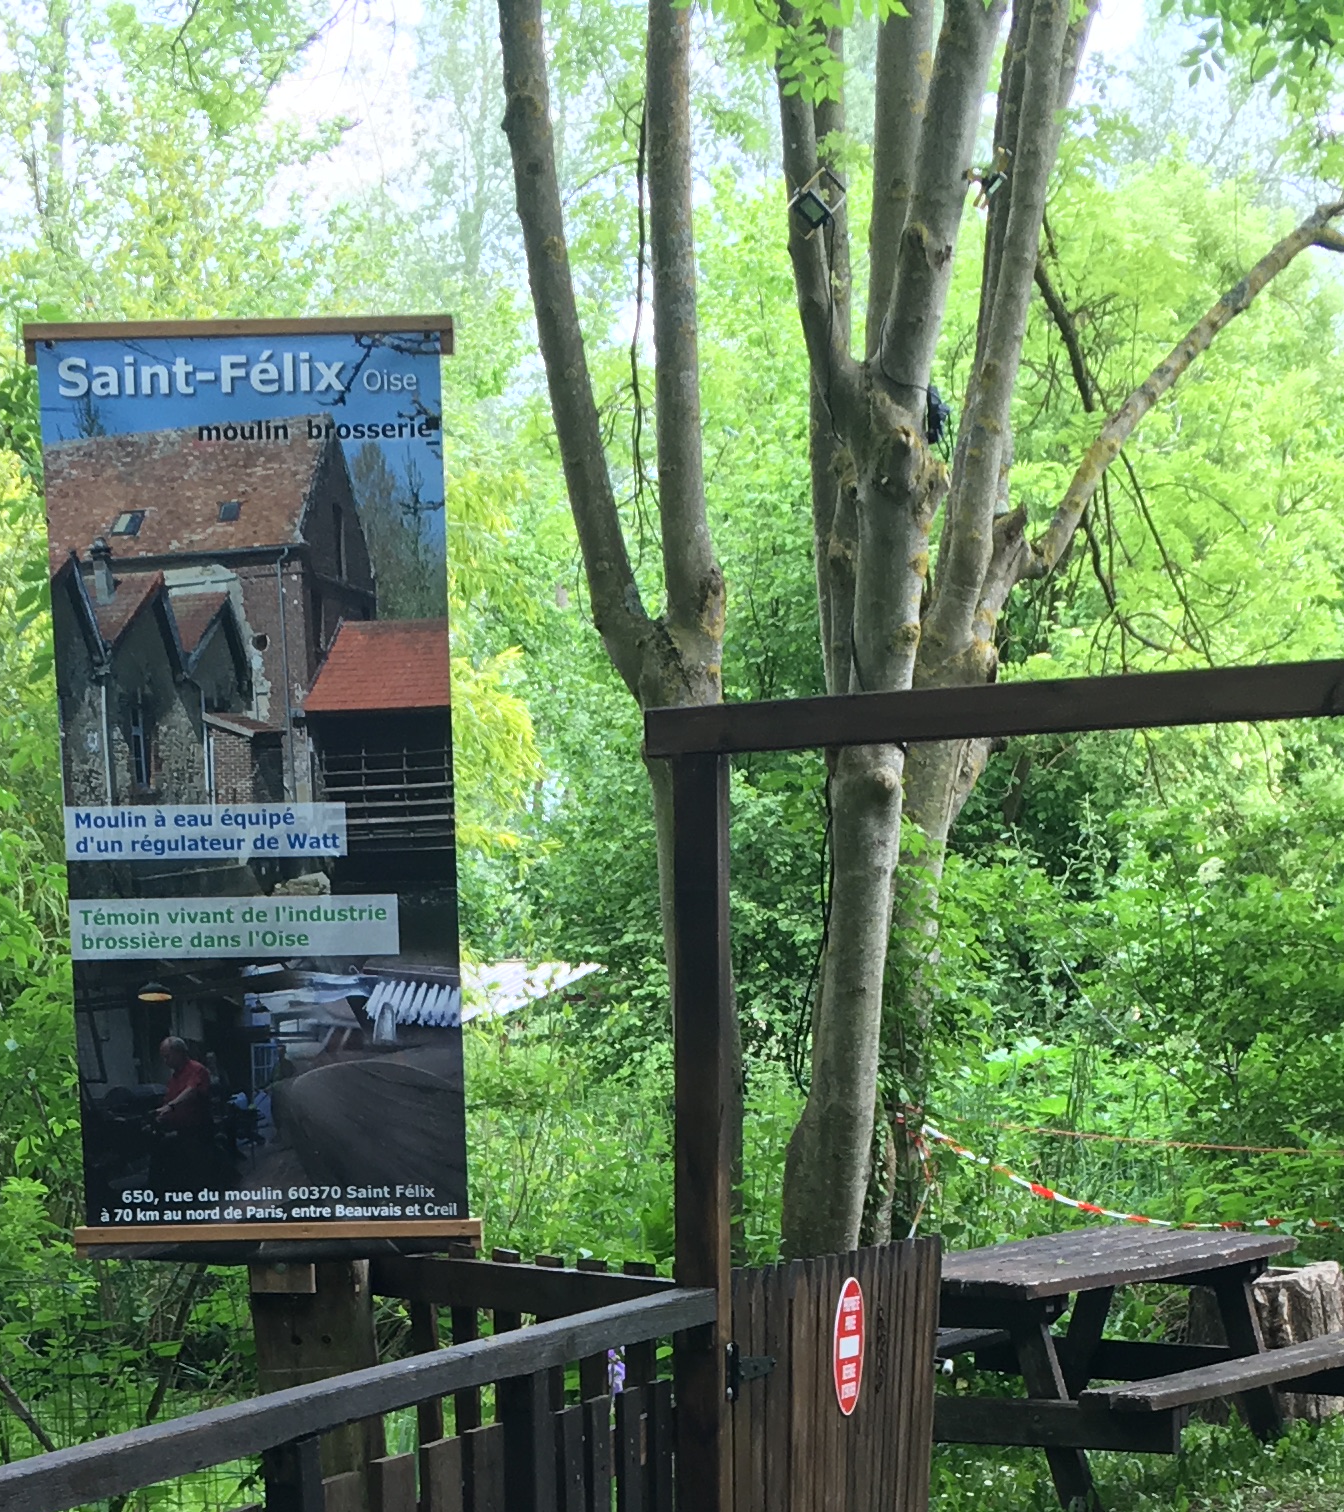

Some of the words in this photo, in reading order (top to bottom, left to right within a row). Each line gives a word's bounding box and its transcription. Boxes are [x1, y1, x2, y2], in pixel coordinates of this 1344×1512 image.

[57, 350, 348, 398] Saint-Félix
[363, 369, 417, 392] Oise
[197, 421, 288, 442] moulin
[307, 417, 432, 440] brosserie
[75, 811, 147, 829] Moulin
[154, 810, 166, 828] à
[174, 814, 213, 828] eau
[220, 808, 295, 829] équipé
[76, 836, 123, 854] d'un
[131, 835, 245, 855] régulateur
[253, 833, 279, 850] de
[287, 832, 340, 849] Watt
[79, 909, 159, 926] Témoin
[167, 908, 234, 924] vivant
[242, 908, 268, 924] de
[275, 905, 387, 922] l'industrie
[81, 932, 183, 951] brossière
[190, 932, 241, 948] dans
[248, 931, 309, 947] l'Oise
[121, 1190, 160, 1205] 650,
[165, 1190, 193, 1202] rue
[198, 1188, 219, 1201] du
[225, 1186, 282, 1201] moulin
[288, 1186, 341, 1199] 60370
[347, 1185, 390, 1199] Saint
[395, 1184, 435, 1198] Félix
[100, 1207, 109, 1222] à
[114, 1209, 133, 1222] 70
[137, 1208, 160, 1221] km
[164, 1209, 182, 1220] au
[186, 1207, 220, 1220] nord
[225, 1206, 242, 1219] de
[246, 1205, 287, 1220] Paris,
[292, 1205, 332, 1218] entre
[336, 1203, 401, 1216] Beauvais
[405, 1205, 420, 1216] et
[424, 1203, 457, 1215] Creil
